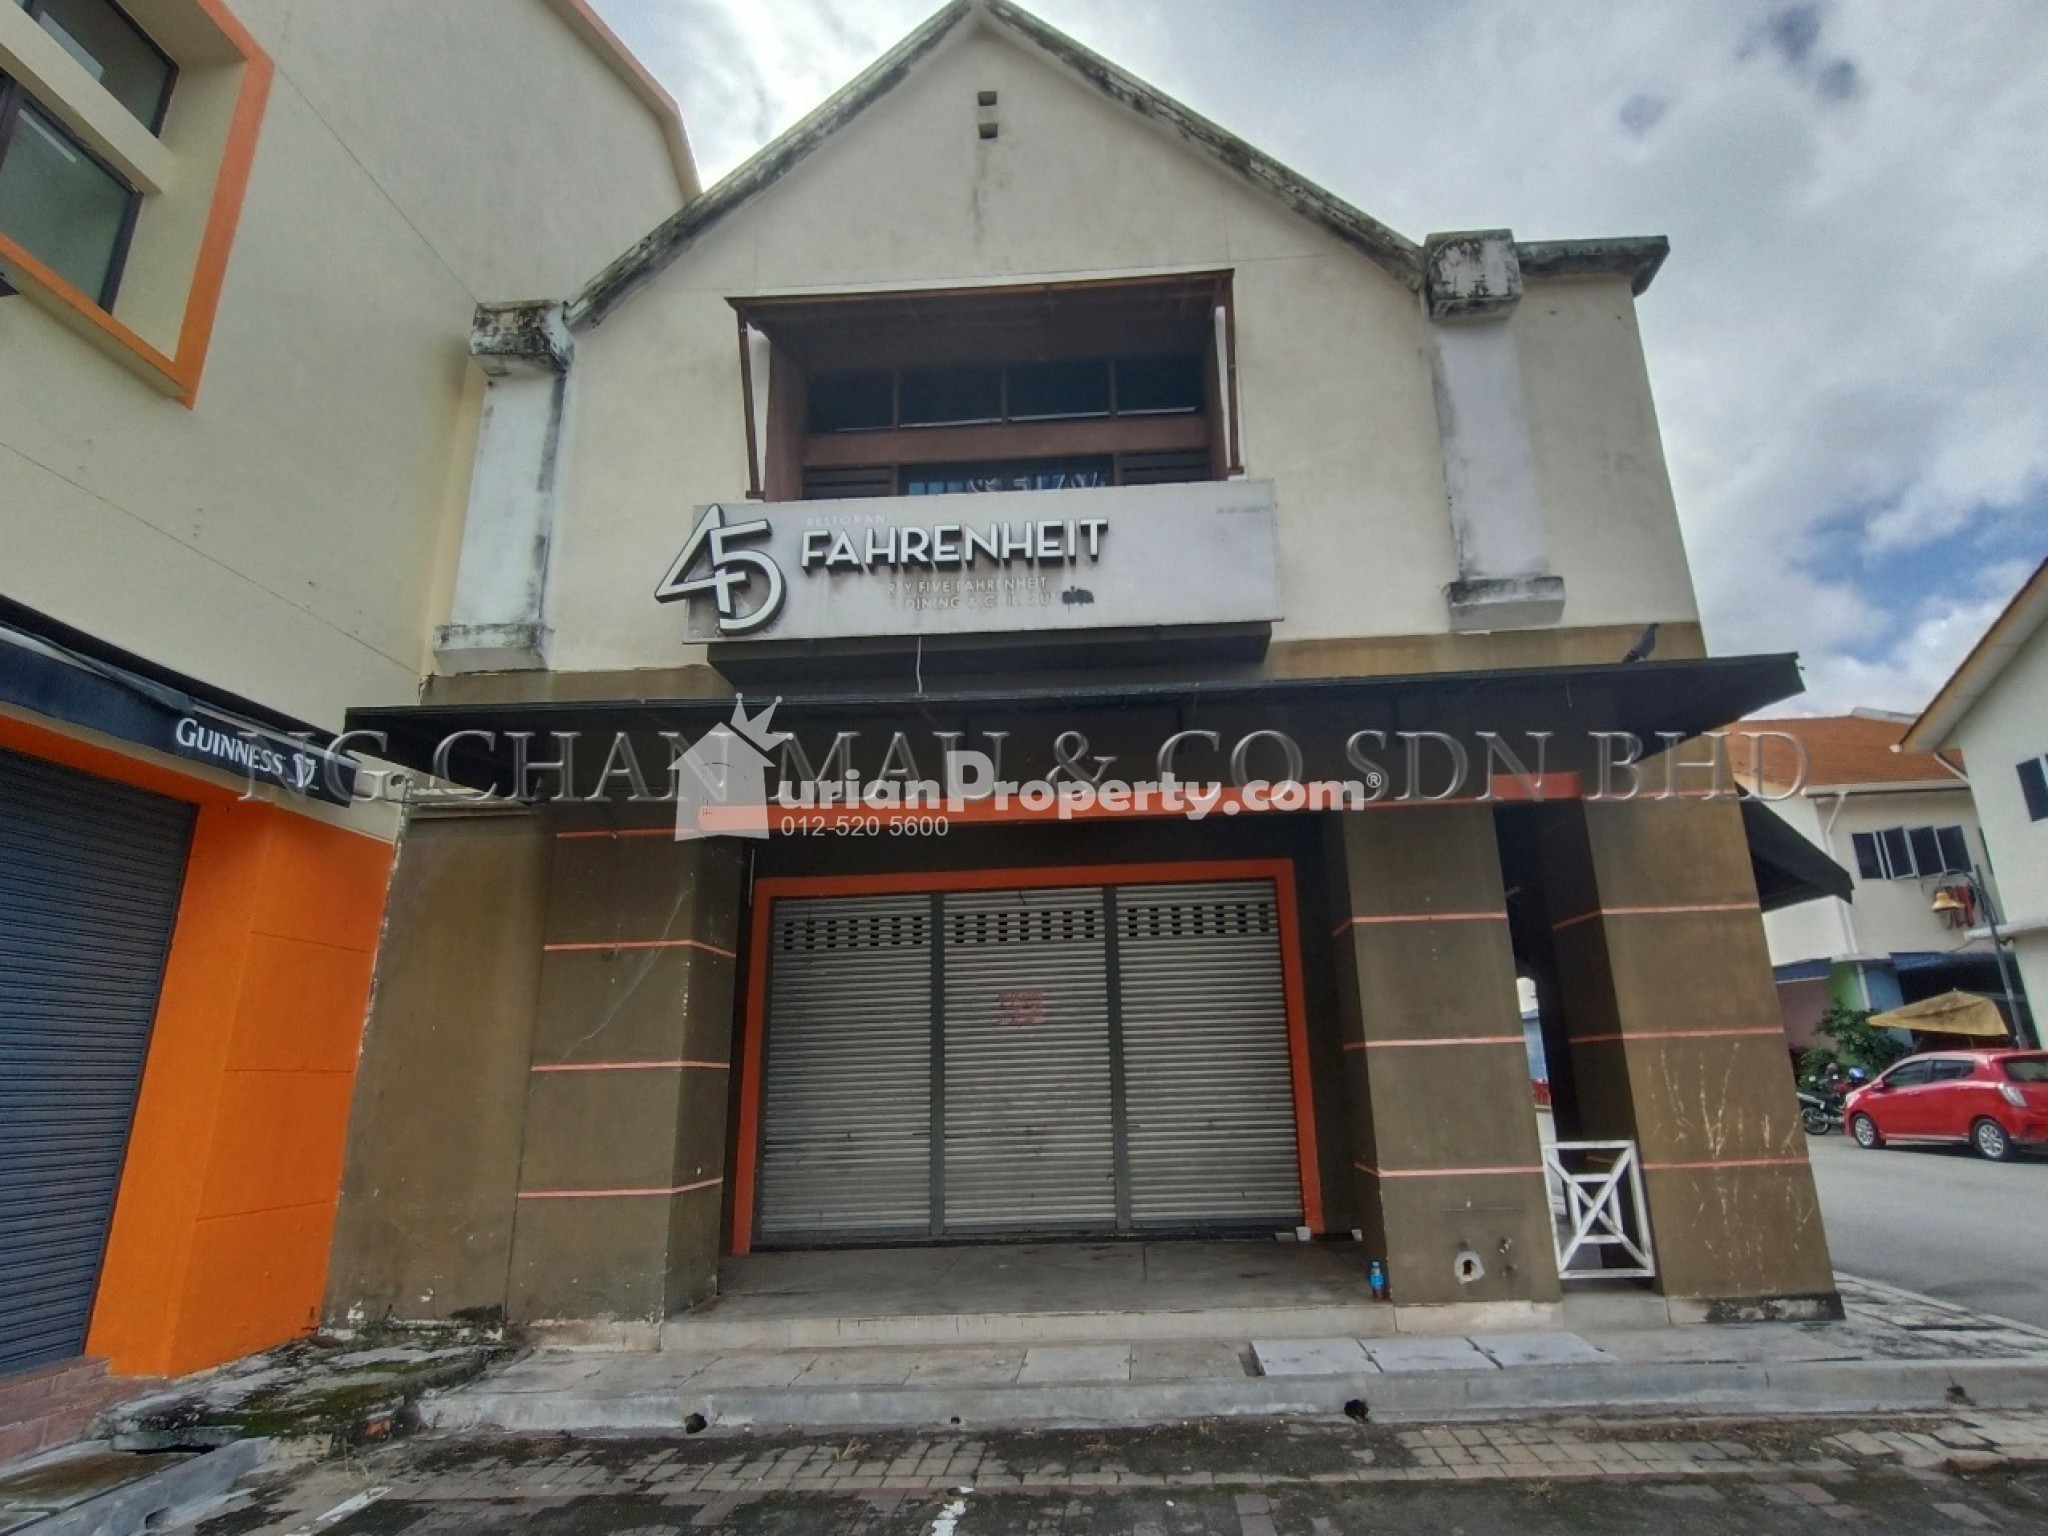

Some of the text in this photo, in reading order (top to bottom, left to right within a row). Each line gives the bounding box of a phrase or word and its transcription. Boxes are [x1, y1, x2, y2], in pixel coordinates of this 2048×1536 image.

[655, 504, 787, 636] 45
[801, 518, 1108, 572] FAHRENHEIT
[918, 580, 951, 593] FIVE
[175, 717, 283, 776] GUINNESS
